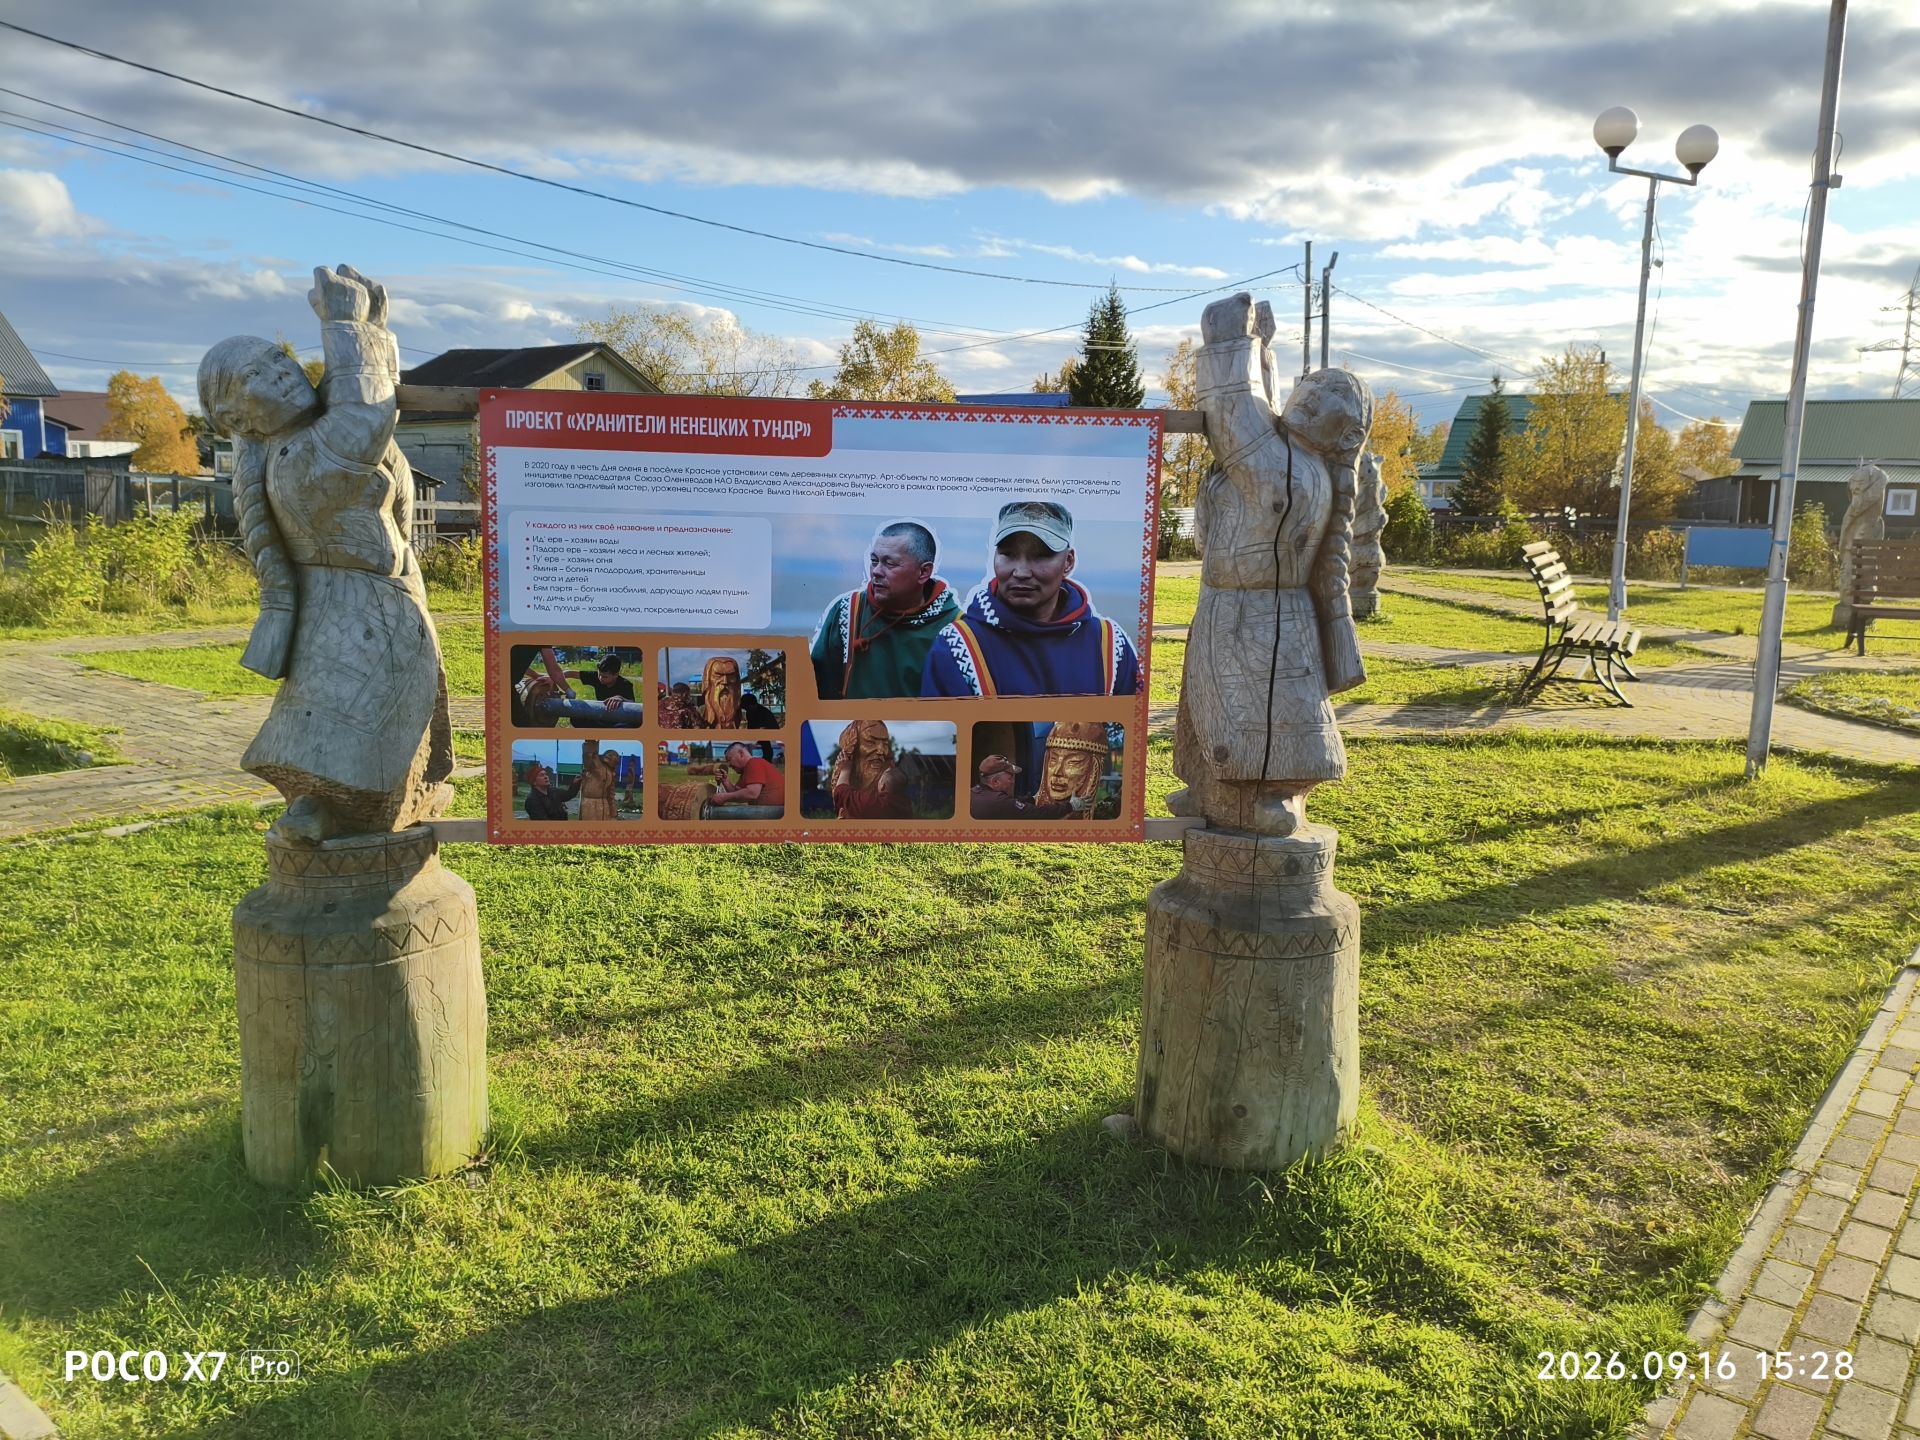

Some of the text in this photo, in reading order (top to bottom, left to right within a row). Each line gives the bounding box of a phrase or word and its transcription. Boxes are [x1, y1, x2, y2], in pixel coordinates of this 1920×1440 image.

[505, 410, 811, 439] ПРОЕКТ «ХРАНИТЕЛИ НЕНЕЦКИХ ТУНДР»
[551, 463, 569, 471] году
[601, 464, 616, 472] Дня
[650, 466, 683, 474] посёлке
[685, 467, 721, 475] Красное
[880, 473, 927, 481] Арт-объекты
[566, 482, 616, 490] талантливый
[617, 484, 650, 492] мастер,
[651, 485, 692, 493] уроженец
[728, 487, 763, 495] Красное
[767, 488, 790, 496] Вылка
[792, 489, 825, 497] Николай
[826, 490, 866, 498] Ефимович.
[574, 473, 631, 481] председателя
[634, 475, 662, 483] Союза
[663, 476, 713, 484] Оленеводов
[734, 477, 781, 486] Владислава
[783, 479, 849, 488] Александровича
[851, 481, 899, 489] Выучейского
[969, 485, 1013, 493] «Хранители
[1050, 487, 1077, 495] тундр».
[1078, 488, 1121, 496] Скульптуры
[532, 522, 566, 530] каждого
[595, 523, 615, 531] своё
[663, 526, 733, 534] предназначение:
[532, 545, 564, 553] Пэдара
[676, 549, 711, 557] жителей;
[544, 556, 560, 564] ерв
[580, 585, 608, 593] богиня
[609, 586, 648, 594] изобилия,
[574, 595, 595, 603] рыбу
[587, 605, 619, 613] хозяйка
